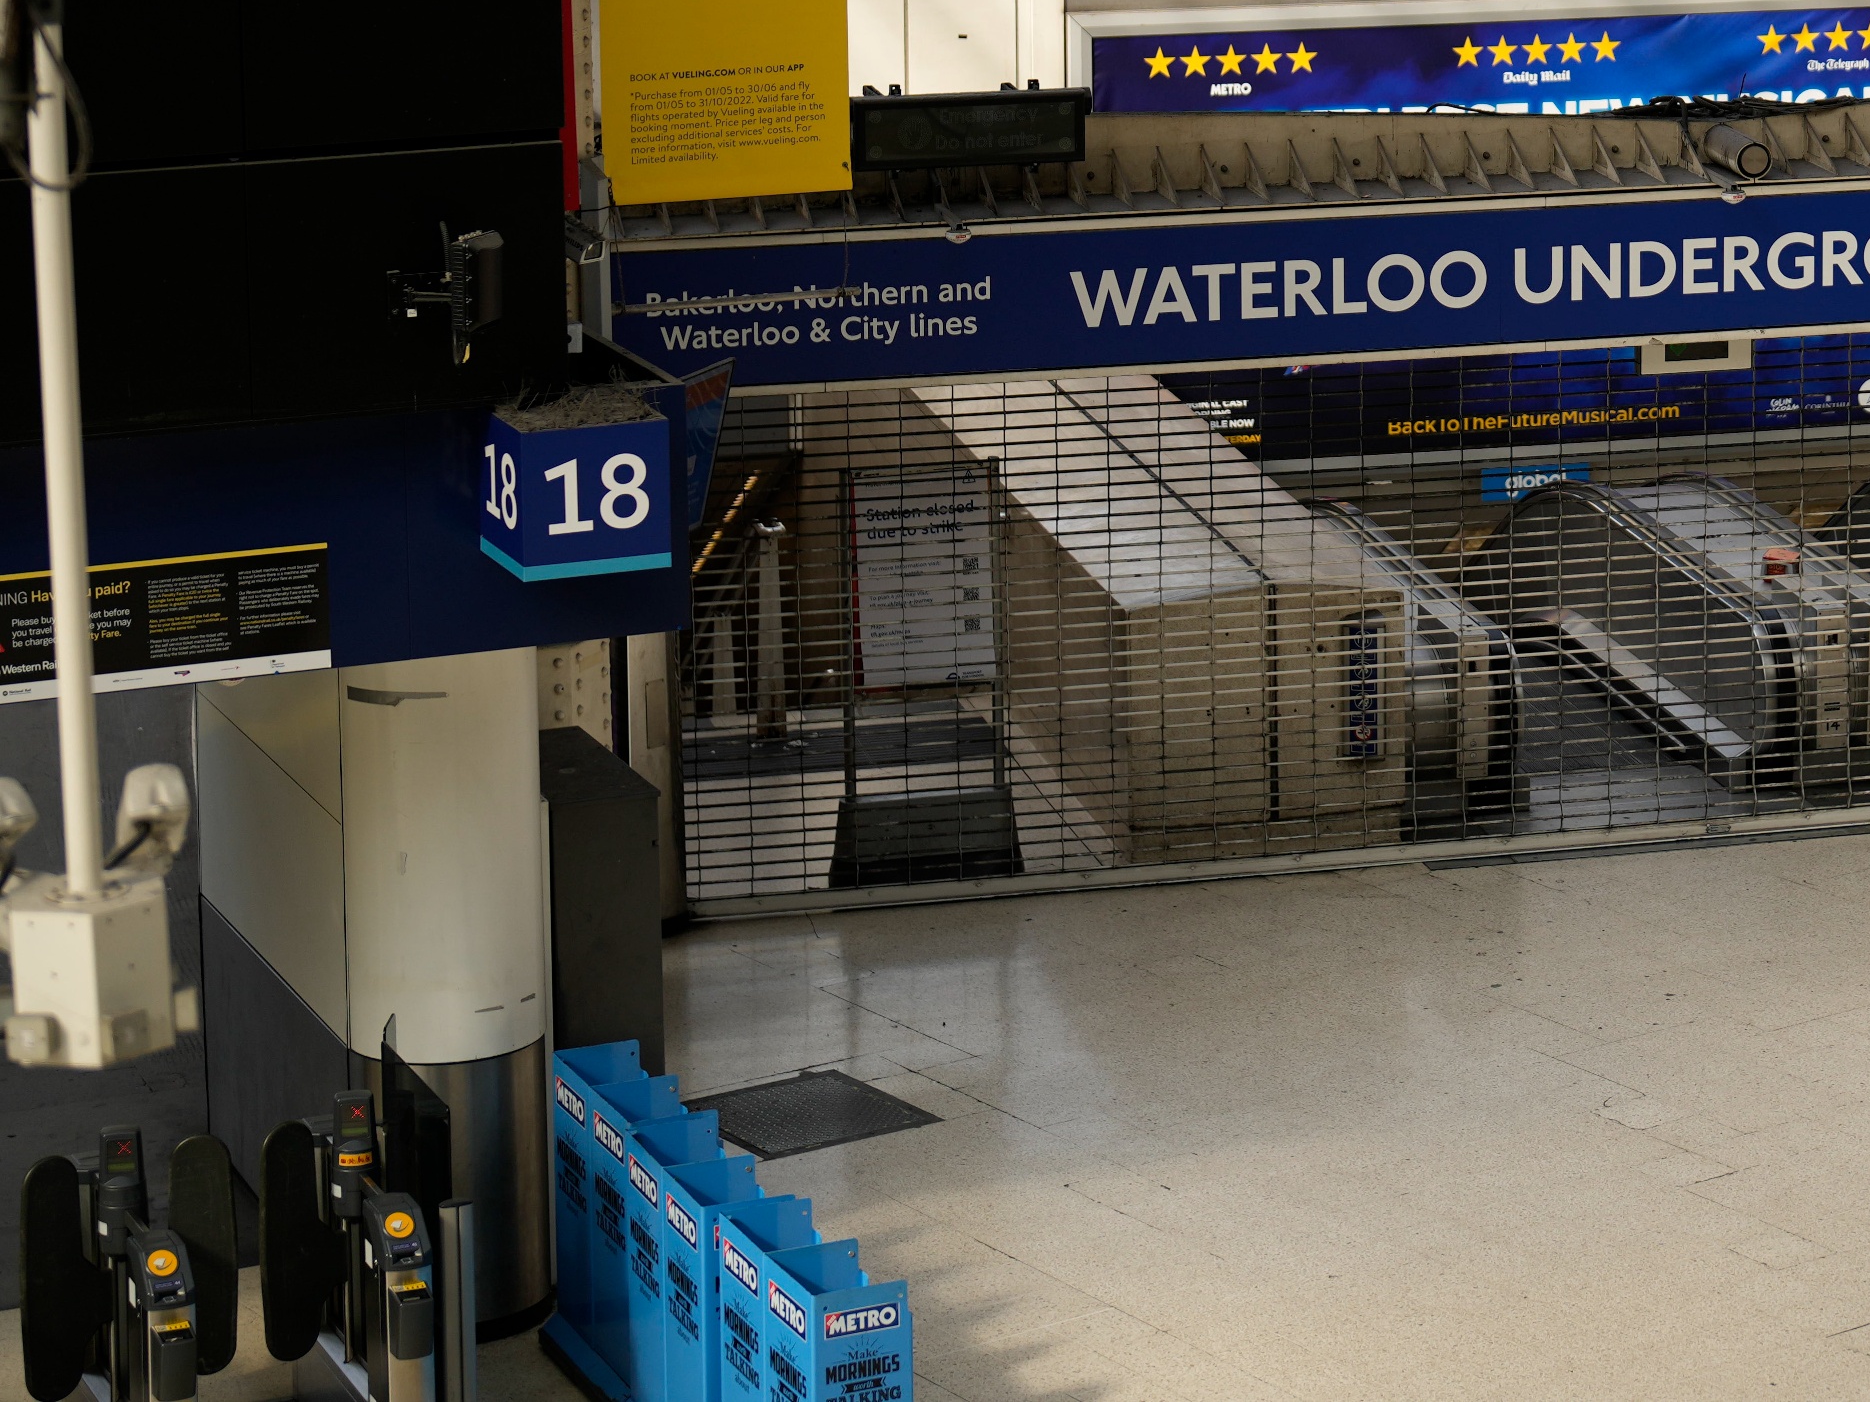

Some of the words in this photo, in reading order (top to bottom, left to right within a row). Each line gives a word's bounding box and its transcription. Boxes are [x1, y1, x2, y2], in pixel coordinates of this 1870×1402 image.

[630, 73, 657, 82] BOOK
[672, 69, 736, 79] VUELING.COM
[738, 67, 751, 75] OR
[754, 66, 763, 74] IN
[765, 65, 785, 73] OUR
[787, 63, 804, 72] APP
[1806, 59, 1825, 72] The
[1826, 58, 1870, 71] Telegraph
[1503, 71, 1538, 86] Daily
[1540, 69, 1571, 83] Mail
[680, 89, 702, 98] from
[705, 86, 732, 96] 01/05
[735, 87, 744, 95] to
[747, 83, 777, 93] 30/06
[779, 82, 796, 91] and
[798, 81, 810, 92] fly
[1210, 83, 1252, 96] METRO
[630, 102, 653, 111] from
[656, 100, 684, 109] 01/05
[686, 100, 696, 108] to
[699, 96, 754, 107] 31/10/2022.
[756, 93, 779, 103] Valid
[781, 92, 799, 101] fare
[801, 91, 815, 100] for
[630, 113, 660, 124] flights
[662, 109, 705, 122] operated
[707, 109, 718, 119] by
[721, 106, 755, 117] Vueling
[757, 104, 796, 114] available
[798, 102, 807, 111] in
[809, 102, 824, 111] the
[630, 123, 668, 134] booking
[670, 120, 712, 130] moment.
[715, 118, 739, 128] Price
[741, 118, 757, 129] per
[759, 116, 773, 125] leg
[775, 114, 792, 123] and
[794, 113, 826, 125] person
[630, 133, 675, 144] excluding
[677, 129, 723, 141] additional
[767, 125, 794, 135] costs.
[796, 124, 812, 132] For
[631, 146, 656, 155] more
[658, 142, 716, 153] information,
[718, 139, 736, 148] visit
[631, 154, 666, 165] Limited
[668, 151, 718, 162] availability.
[645, 288, 784, 318] Bakerloo,
[793, 281, 929, 311] Northern
[938, 275, 992, 302] and
[1069, 250, 1488, 328] WATERLOO
[660, 321, 800, 350] Waterloo
[809, 318, 832, 343] &
[840, 314, 901, 345] City
[909, 312, 978, 338] lines
[1229, 418, 1255, 428] NOW
[484, 443, 518, 530] 18
[543, 452, 650, 536] 18
[867, 526, 896, 540] due
[95, 581, 131, 599] paid?
[103, 607, 131, 618] before
[11, 618, 39, 627] Please
[96, 620, 112, 631] you
[113, 618, 132, 629] may
[11, 630, 27, 640] you
[28, 626, 52, 636] travel
[101, 629, 122, 638] Fare.
[12, 639, 23, 648] be
[2, 662, 41, 674] Western
[557, 1085, 584, 1122] METRO
[595, 1119, 623, 1159] METRO
[630, 1163, 657, 1204] METRO
[669, 1200, 696, 1245] METRO
[725, 1249, 757, 1291] METRO
[770, 1291, 805, 1335] METRO
[828, 1305, 897, 1336] METRO
[849, 1348, 879, 1360] Make
[825, 1353, 900, 1385] MORNINGS
